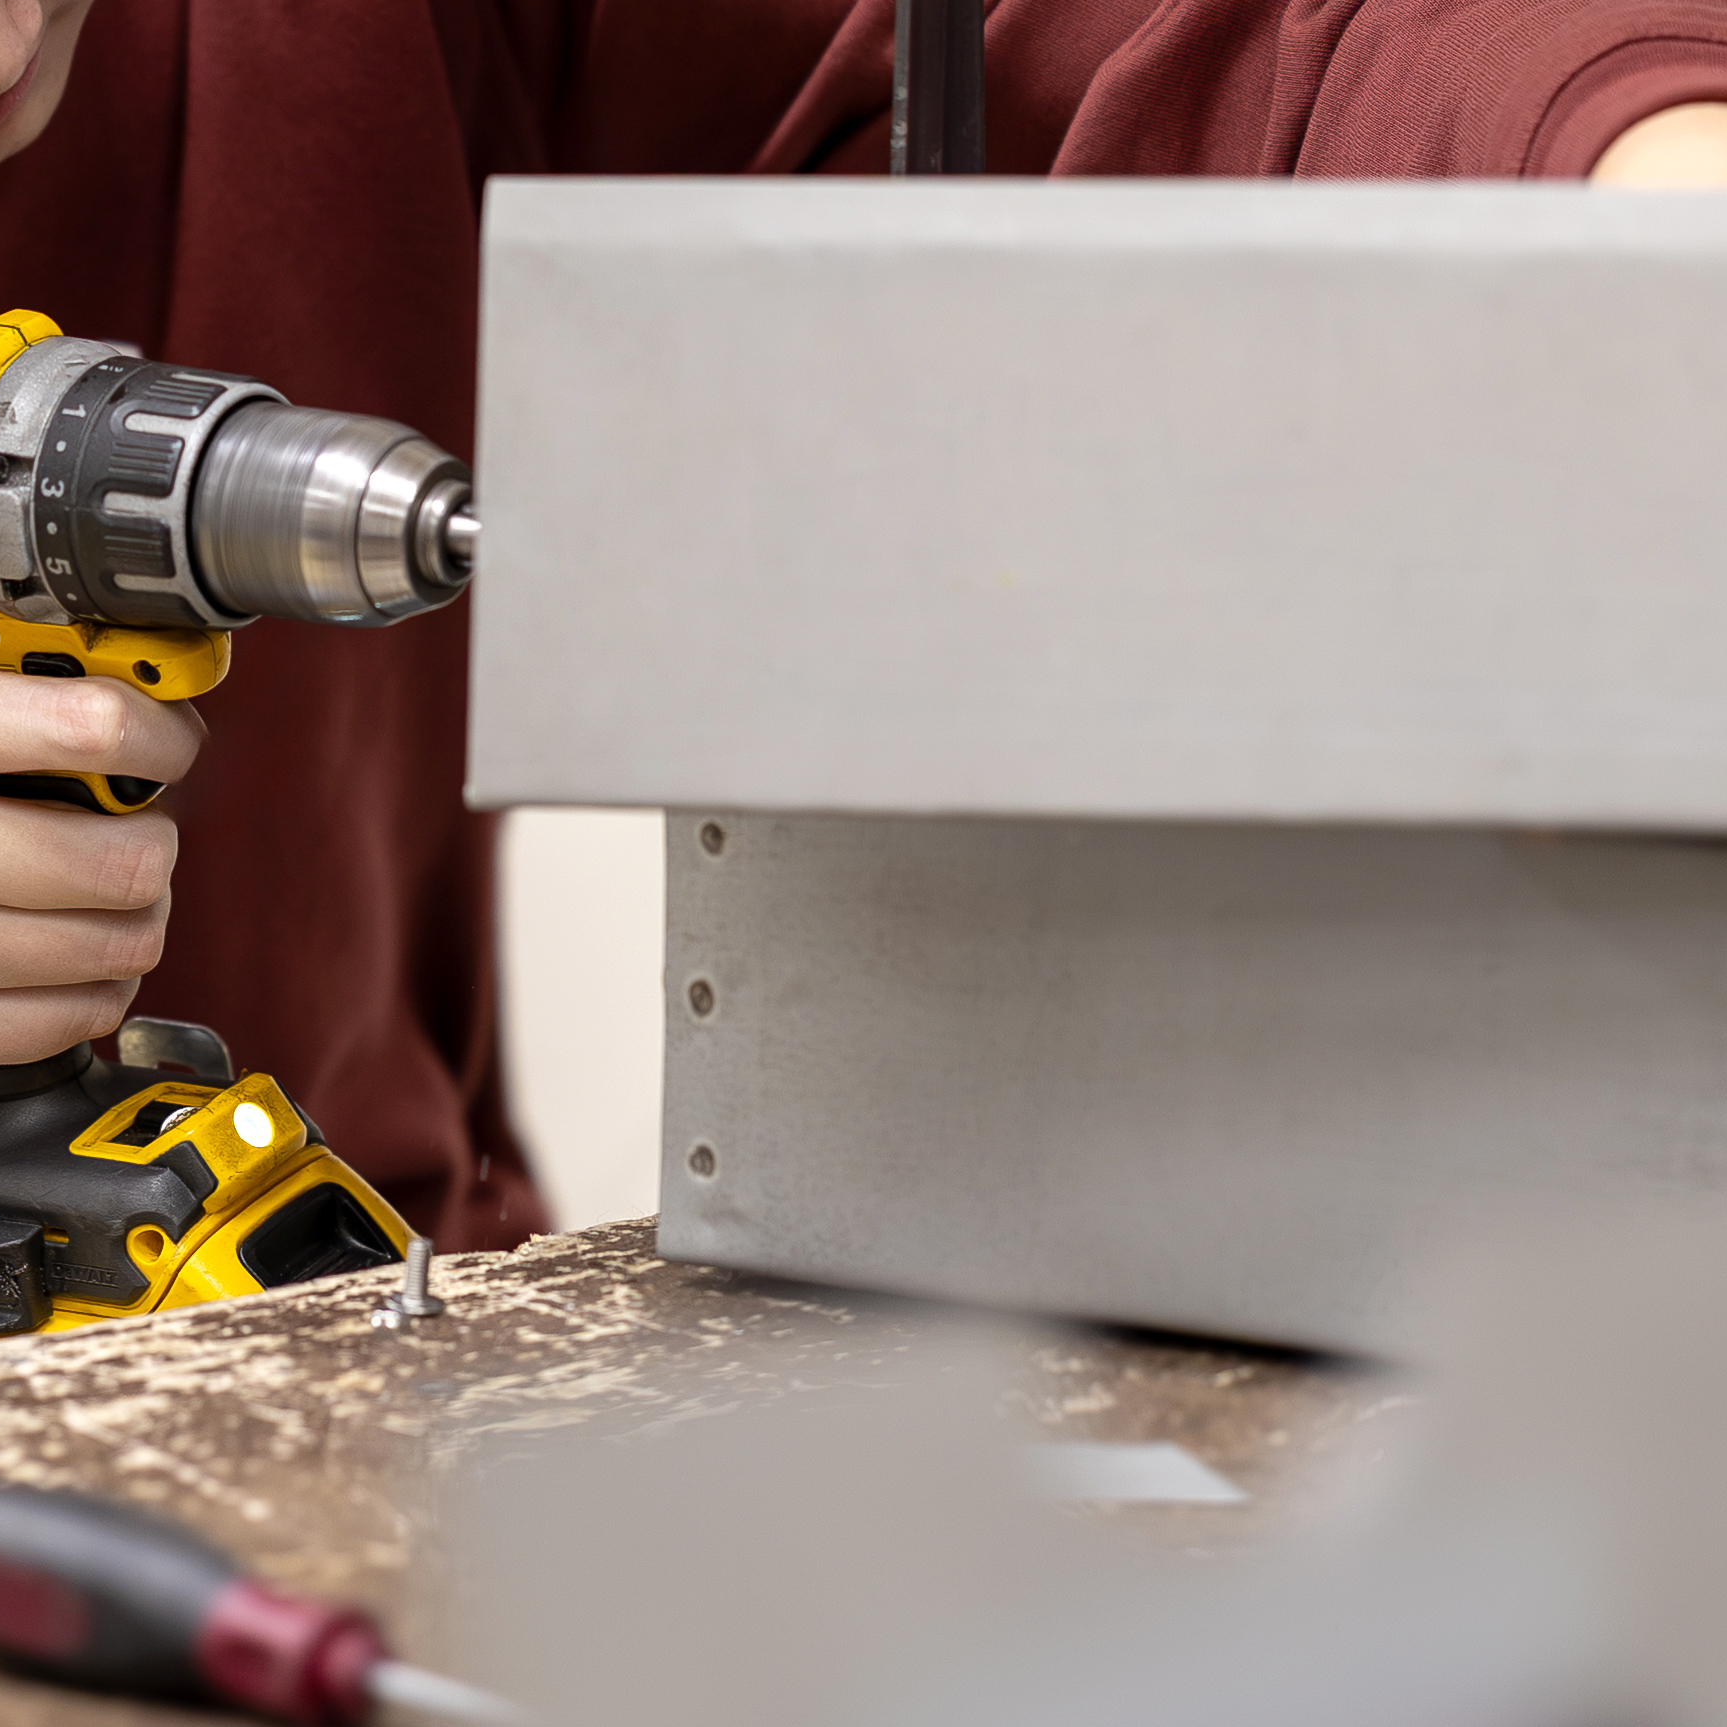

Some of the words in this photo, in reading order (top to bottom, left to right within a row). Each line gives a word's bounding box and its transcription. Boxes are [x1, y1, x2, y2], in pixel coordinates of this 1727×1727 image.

[62, 404, 86, 418] 1
[41, 477, 65, 498] 3
[46, 557, 72, 575] 5
